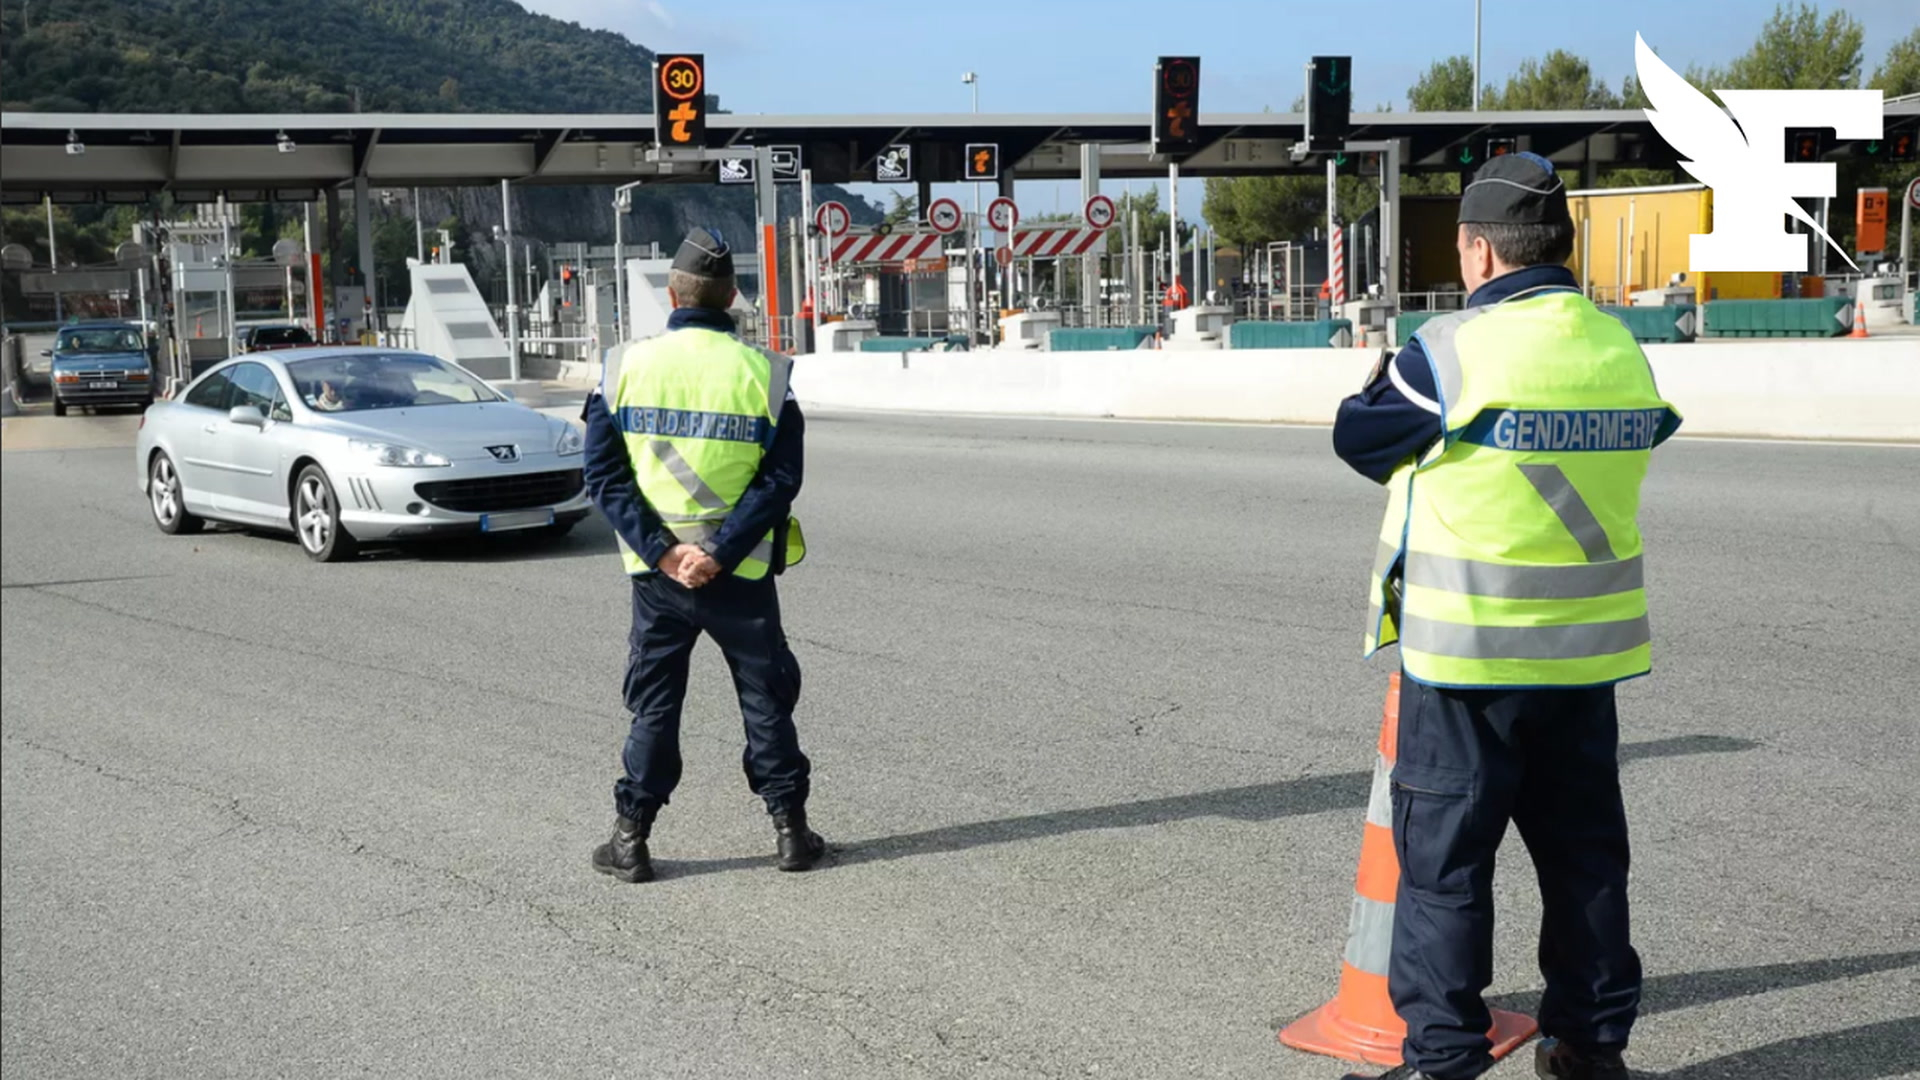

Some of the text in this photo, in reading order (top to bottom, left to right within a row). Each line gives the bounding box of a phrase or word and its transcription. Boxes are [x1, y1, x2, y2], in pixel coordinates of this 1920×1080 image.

[670, 69, 694, 88] 30
[668, 101, 697, 142] t
[631, 409, 756, 441] GENDARMERIE
